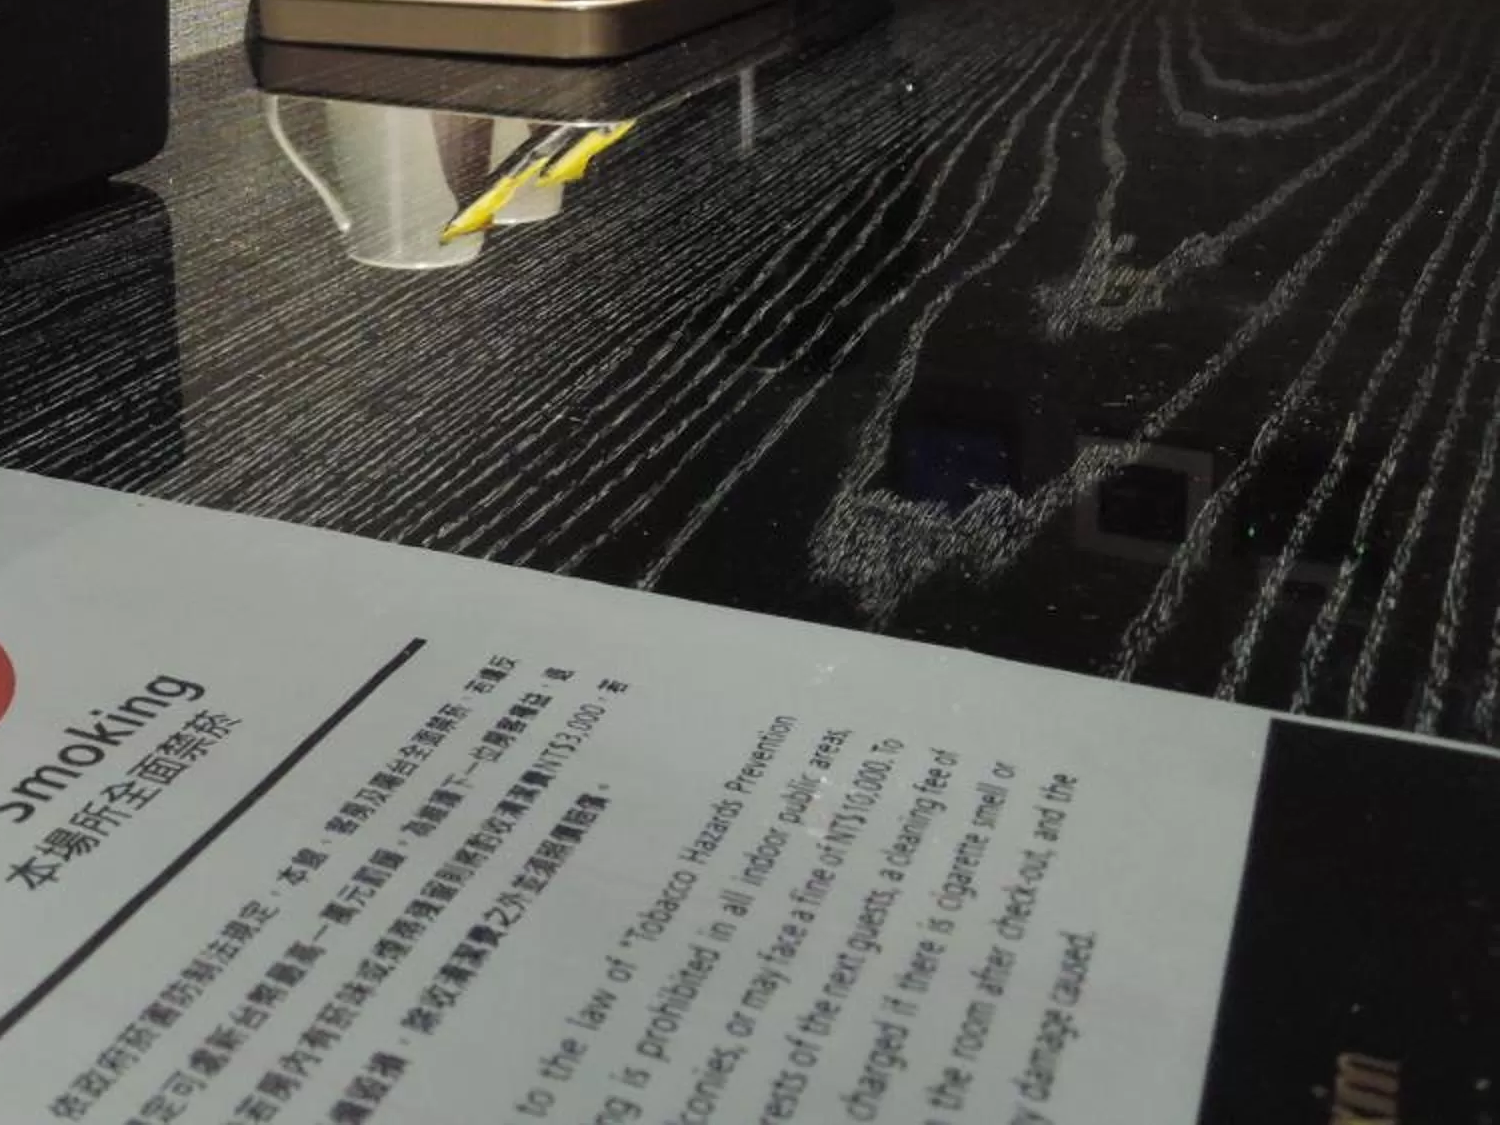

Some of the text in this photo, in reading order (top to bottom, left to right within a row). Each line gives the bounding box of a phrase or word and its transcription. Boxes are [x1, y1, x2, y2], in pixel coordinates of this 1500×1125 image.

[870, 739, 904, 753] To
[931, 747, 958, 766] of
[912, 768, 952, 795] fee
[1040, 774, 1078, 803] the
[882, 797, 948, 867] cleaning
[1034, 806, 1066, 842] and
[816, 843, 846, 867] of
[789, 868, 836, 905] fine
[879, 869, 905, 882] a
[516, 1090, 554, 1117] to
[540, 1039, 587, 1081] the
[566, 989, 617, 1031] law
[606, 955, 636, 982] of
[680, 799, 744, 864] Hazards
[724, 716, 797, 794] Prevention
[610, 1067, 651, 1088] is
[636, 945, 720, 1063] prohibited
[698, 922, 736, 941] in
[720, 890, 754, 917] all
[740, 827, 788, 886] indoor
[778, 772, 820, 825] public
[791, 909, 815, 923] a
[757, 924, 808, 964] face
[840, 761, 1015, 1121] charged if there is cigarette smell or
[741, 967, 790, 1009] may
[822, 952, 865, 998] next
[970, 945, 1015, 997] after
[725, 1011, 755, 1037] or
[797, 1000, 841, 1035] the
[952, 1001, 995, 1060] room
[786, 1035, 819, 1067] of
[1014, 1009, 1080, 1101] damage
[927, 1067, 973, 1111] the
